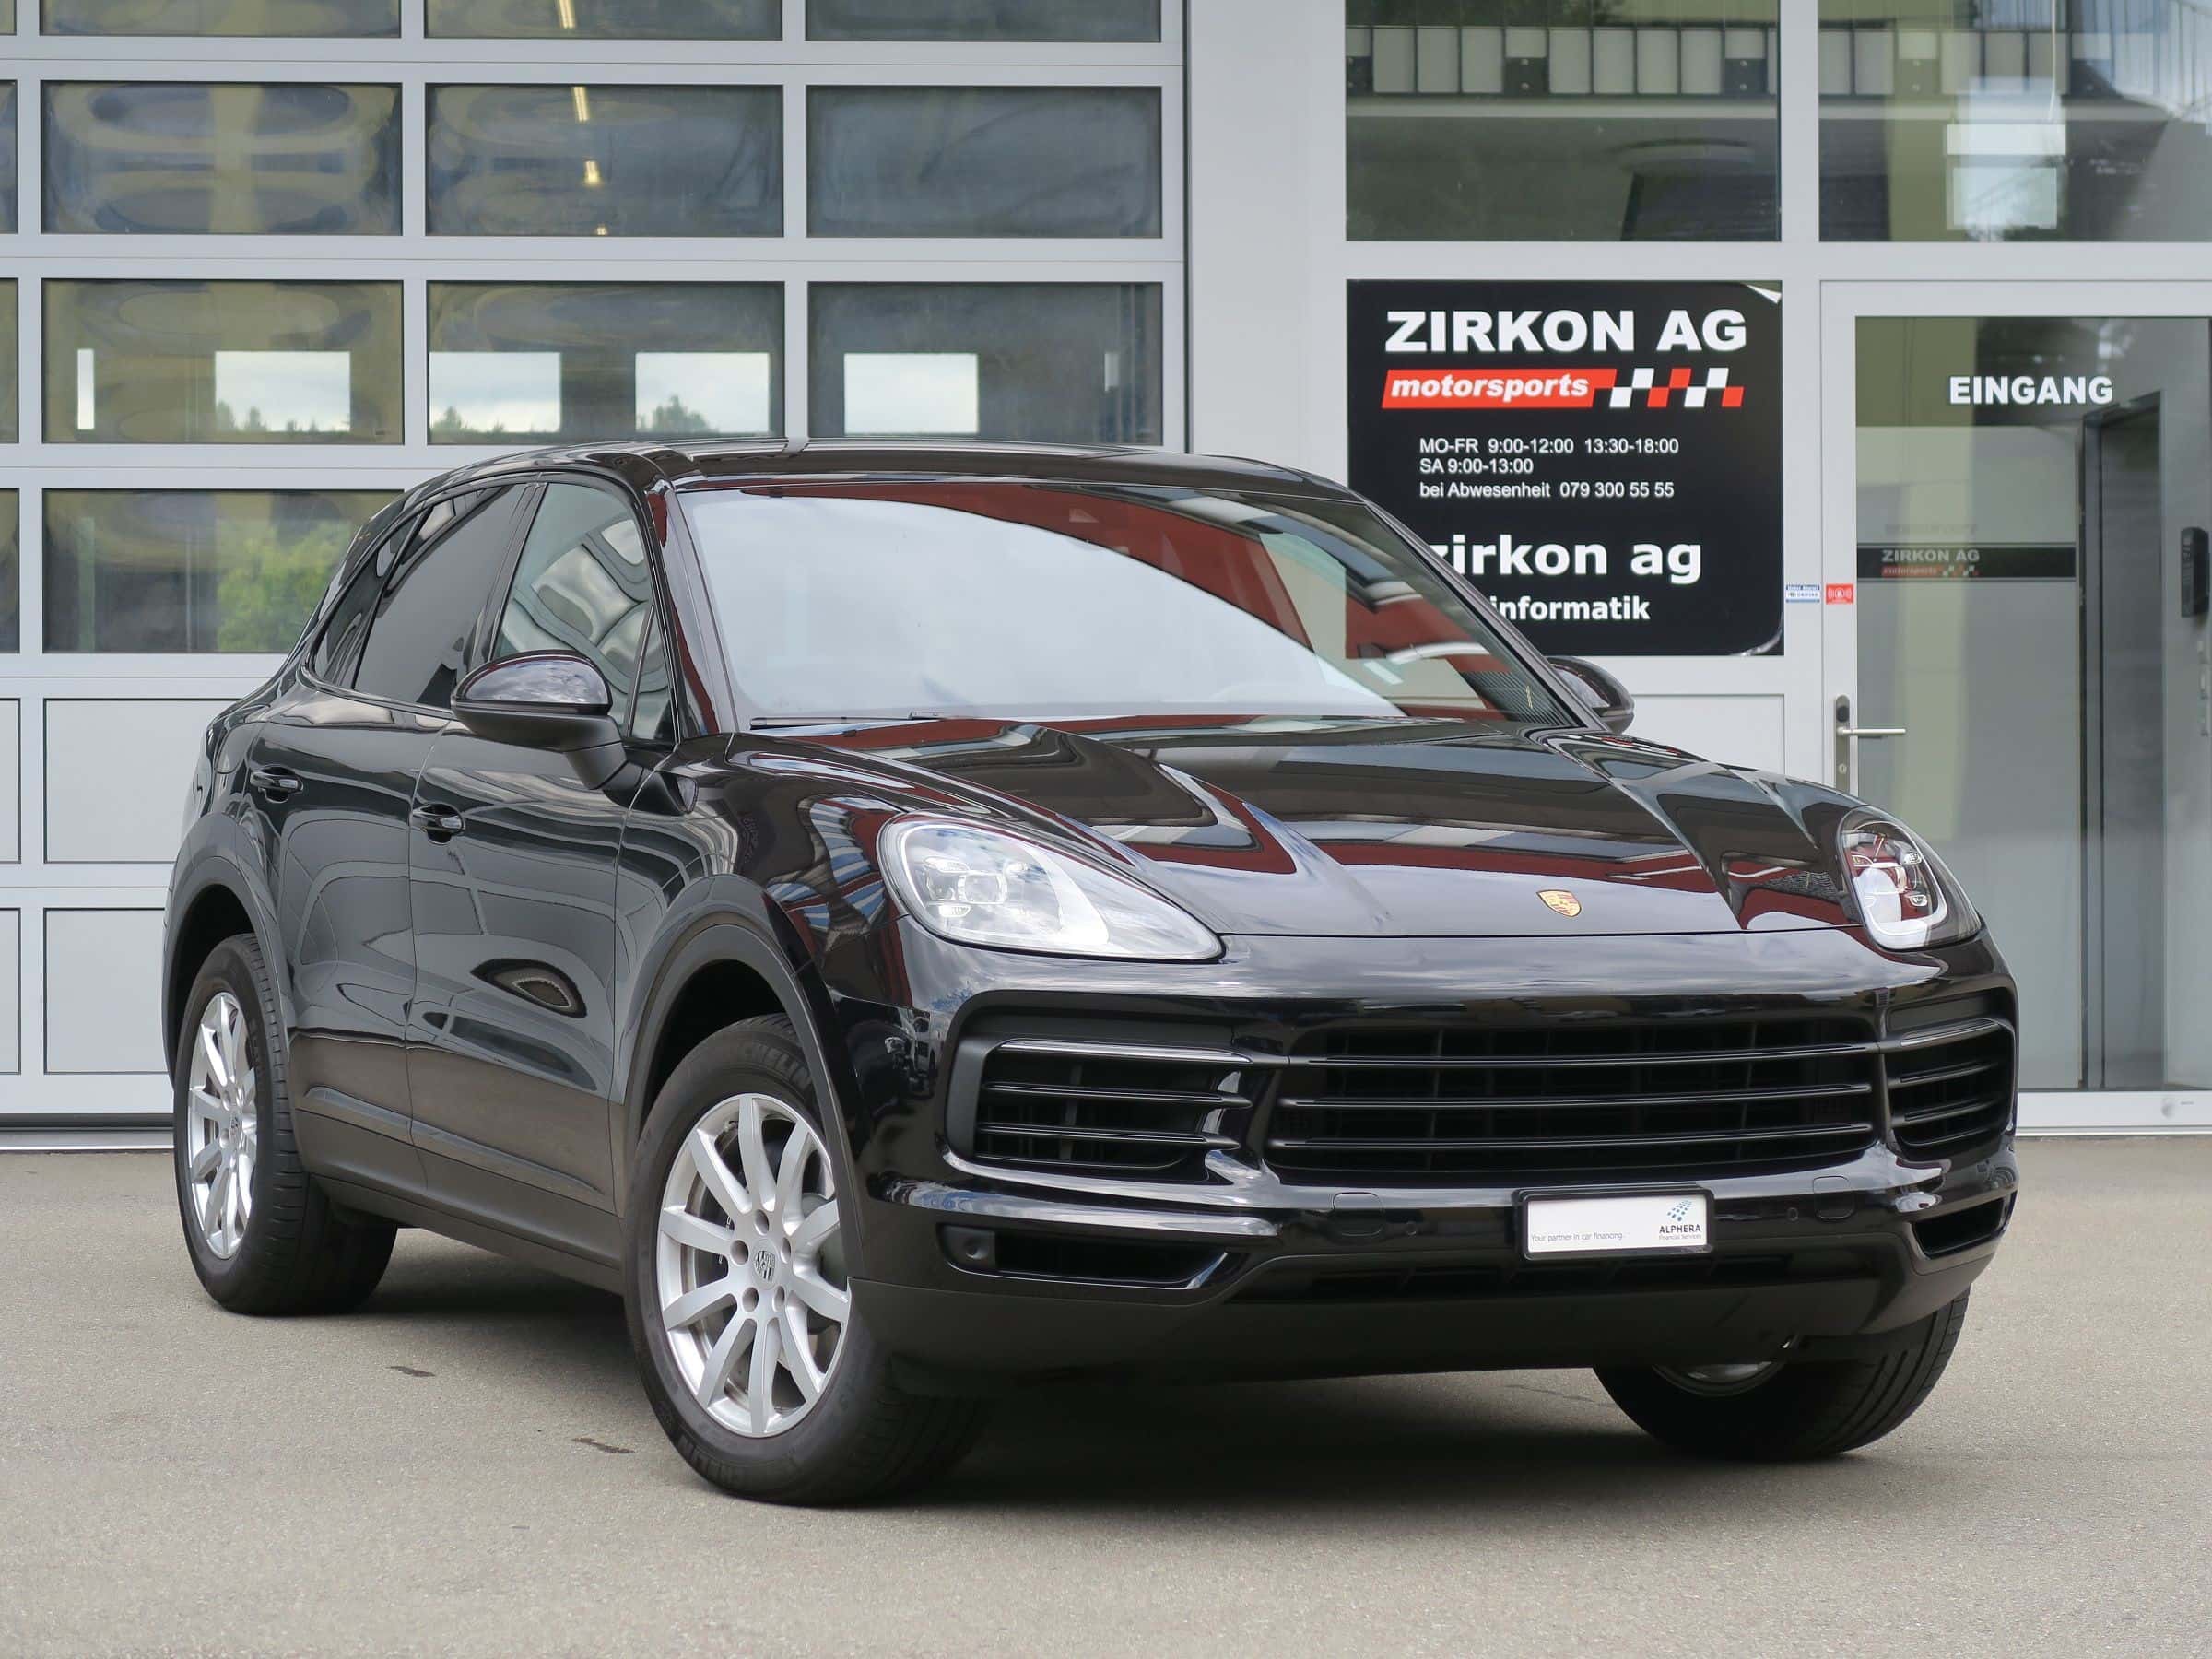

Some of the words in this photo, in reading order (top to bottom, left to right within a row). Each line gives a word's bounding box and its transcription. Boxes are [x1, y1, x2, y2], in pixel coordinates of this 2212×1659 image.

[1384, 309, 1635, 353] ZIRKON
[1655, 309, 1747, 353] AG
[1390, 374, 1589, 403] motorsports
[1949, 376, 2113, 406] EINGANG
[1419, 437, 1479, 454] MO-FR
[1488, 437, 1574, 454] 9:00-12:00
[1584, 437, 1679, 454] 13:30-18:00
[1419, 457, 1444, 475] SA
[1447, 457, 1535, 475] 9:00-13:00
[1419, 481, 1444, 498] bei
[1447, 481, 1551, 498] Abwesenheit
[1559, 481, 1591, 498] 079
[1594, 481, 1625, 498] 300
[1629, 481, 1650, 498] 55
[1653, 481, 1675, 498] 55
[1630, 542, 1701, 585] ag
[1881, 549, 1950, 562] ZIRKON
[1955, 549, 1981, 562] AG
[1659, 1223, 1701, 1234] ALPHERA
[1547, 1233, 1572, 1242] partner
